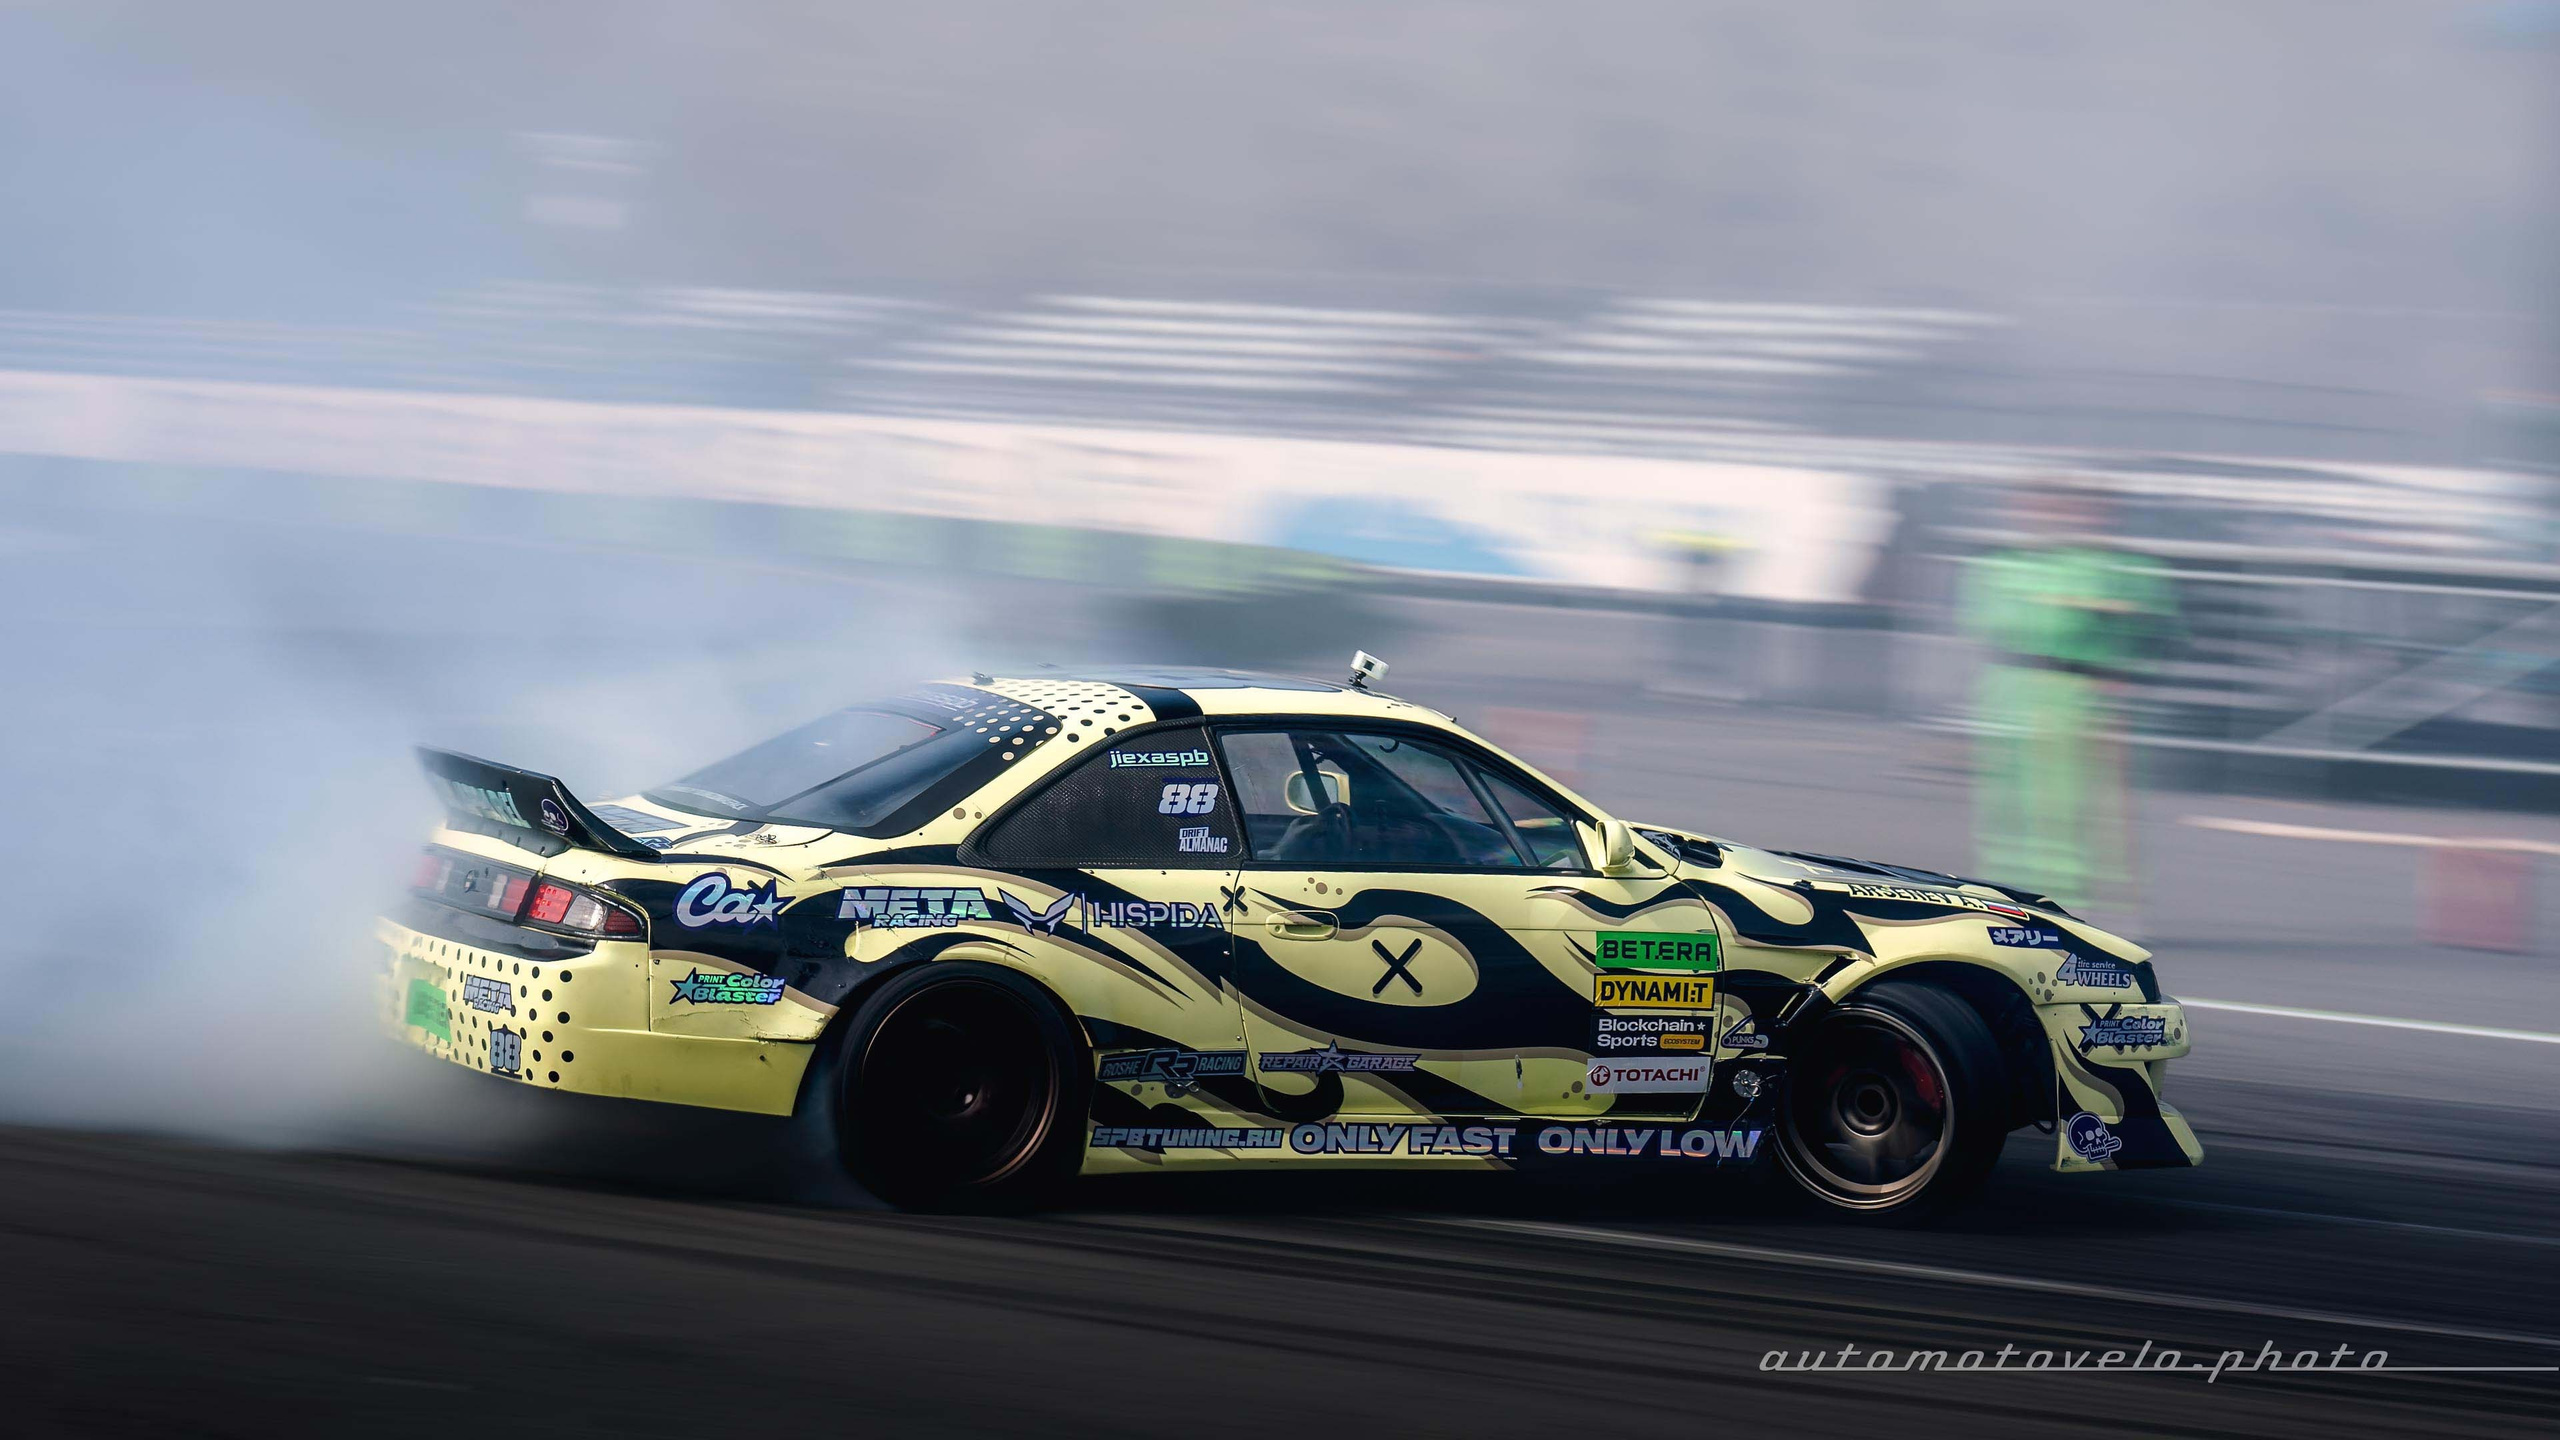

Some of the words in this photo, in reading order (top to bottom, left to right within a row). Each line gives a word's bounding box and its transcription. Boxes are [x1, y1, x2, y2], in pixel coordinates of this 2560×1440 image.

[1109, 749, 1209, 768] jiexaspb
[1158, 783, 1219, 814] 88
[1181, 828, 1207, 838] DRIFT
[1178, 837, 1228, 853] ALMANAC
[838, 888, 993, 919] META
[874, 914, 959, 928] RACING
[1093, 902, 1224, 928] HISPIDA
[1993, 928, 2059, 946] メアリー
[2057, 953, 2078, 986] 4
[2077, 971, 2131, 988] WHEELS
[2091, 961, 2116, 969] service
[698, 975, 725, 983] PRINT
[726, 974, 786, 988] Color
[463, 975, 513, 1010] META
[693, 988, 781, 1003] Blaster
[1598, 1019, 1695, 1032] Blockchain
[2099, 1020, 2120, 1028] PRINT
[2121, 1018, 2164, 1031] Color
[1597, 1034, 1658, 1049] Sports
[1732, 1035, 1755, 1044] PUNKS
[2096, 1030, 2162, 1044] Blaster
[490, 1031, 521, 1071] 88
[1198, 1056, 1243, 1072] RACING
[1261, 1056, 1322, 1069] REPAIR
[1346, 1056, 1416, 1069] GARAGE
[1092, 1127, 1284, 1148] SPBTUNING.RU
[1293, 1125, 1404, 1154] ONLY
[1409, 1128, 1517, 1154] FAST
[1538, 1127, 1657, 1156] ONLY
[1660, 1130, 1762, 1158] LOW
